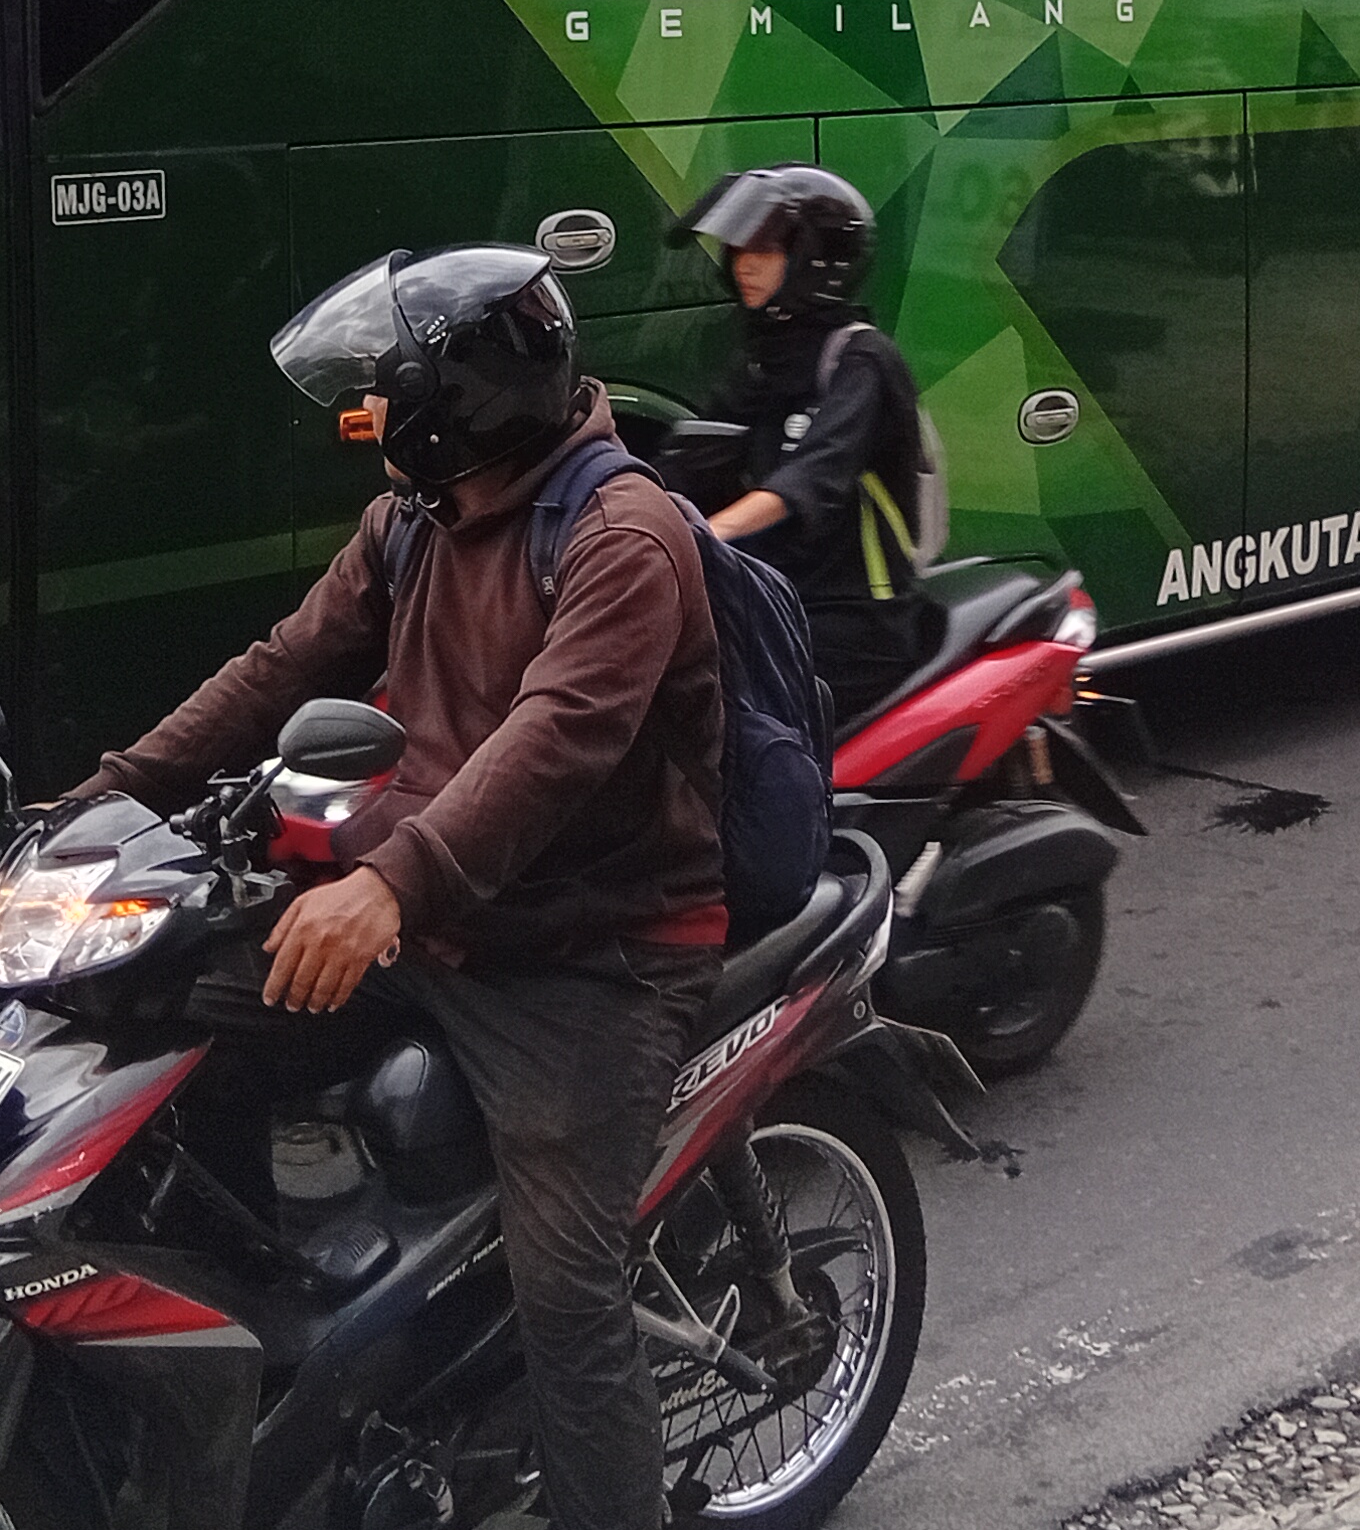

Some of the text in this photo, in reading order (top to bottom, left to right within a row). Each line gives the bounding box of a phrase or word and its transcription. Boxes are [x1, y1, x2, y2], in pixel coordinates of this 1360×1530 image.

[56, 178, 160, 216] MJG-03A
[667, 1000, 780, 1113] REVO
[3, 1263, 99, 1302] HONDA
